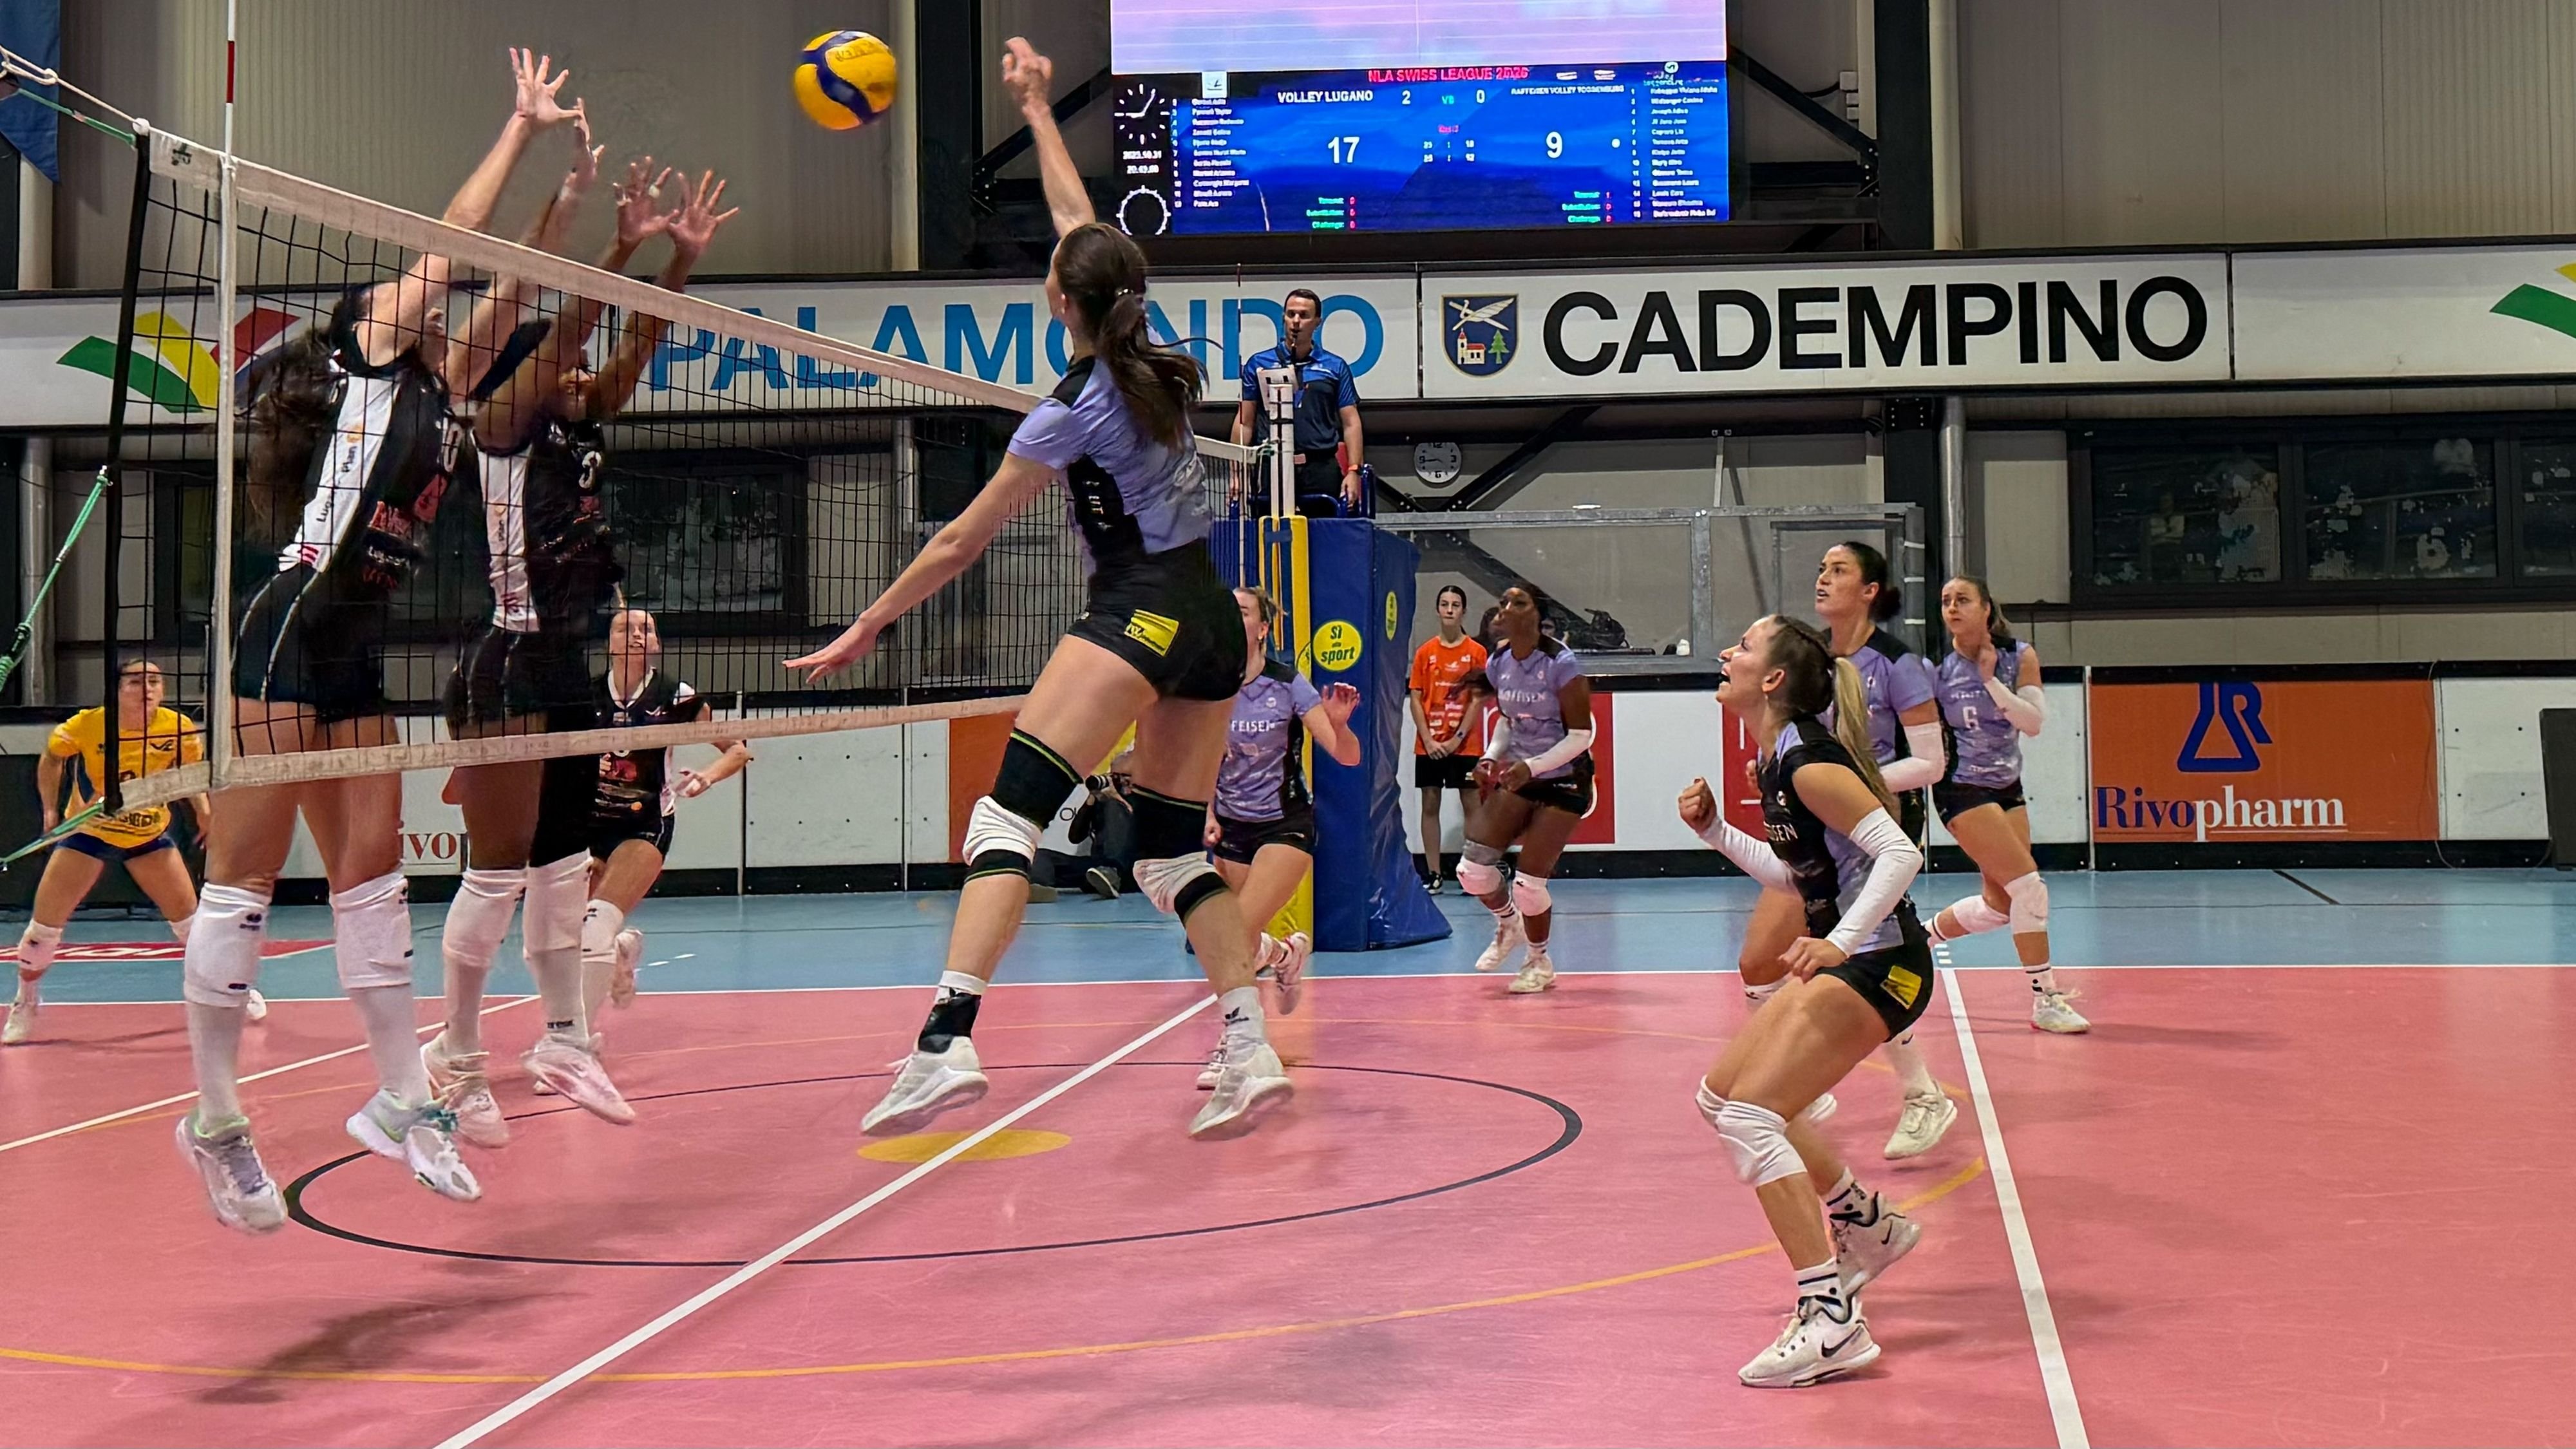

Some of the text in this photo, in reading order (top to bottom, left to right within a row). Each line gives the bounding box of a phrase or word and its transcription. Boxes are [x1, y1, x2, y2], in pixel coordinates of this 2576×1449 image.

[1368, 70, 1393, 82] NLA
[1396, 68, 1437, 82] SWISS
[1441, 67, 1493, 80] LEAGUE
[1278, 90, 1373, 103] VOLLEY LUGANO
[1401, 91, 1410, 104] 2
[1476, 89, 1485, 104] 0
[1327, 136, 1360, 164] 17
[1546, 131, 1563, 158] 9
[1543, 275, 2208, 376] CADEMPINO
[1321, 647, 1355, 665] sport
[1962, 706, 1982, 731] 6
[2096, 784, 2347, 842] Rivopharm
